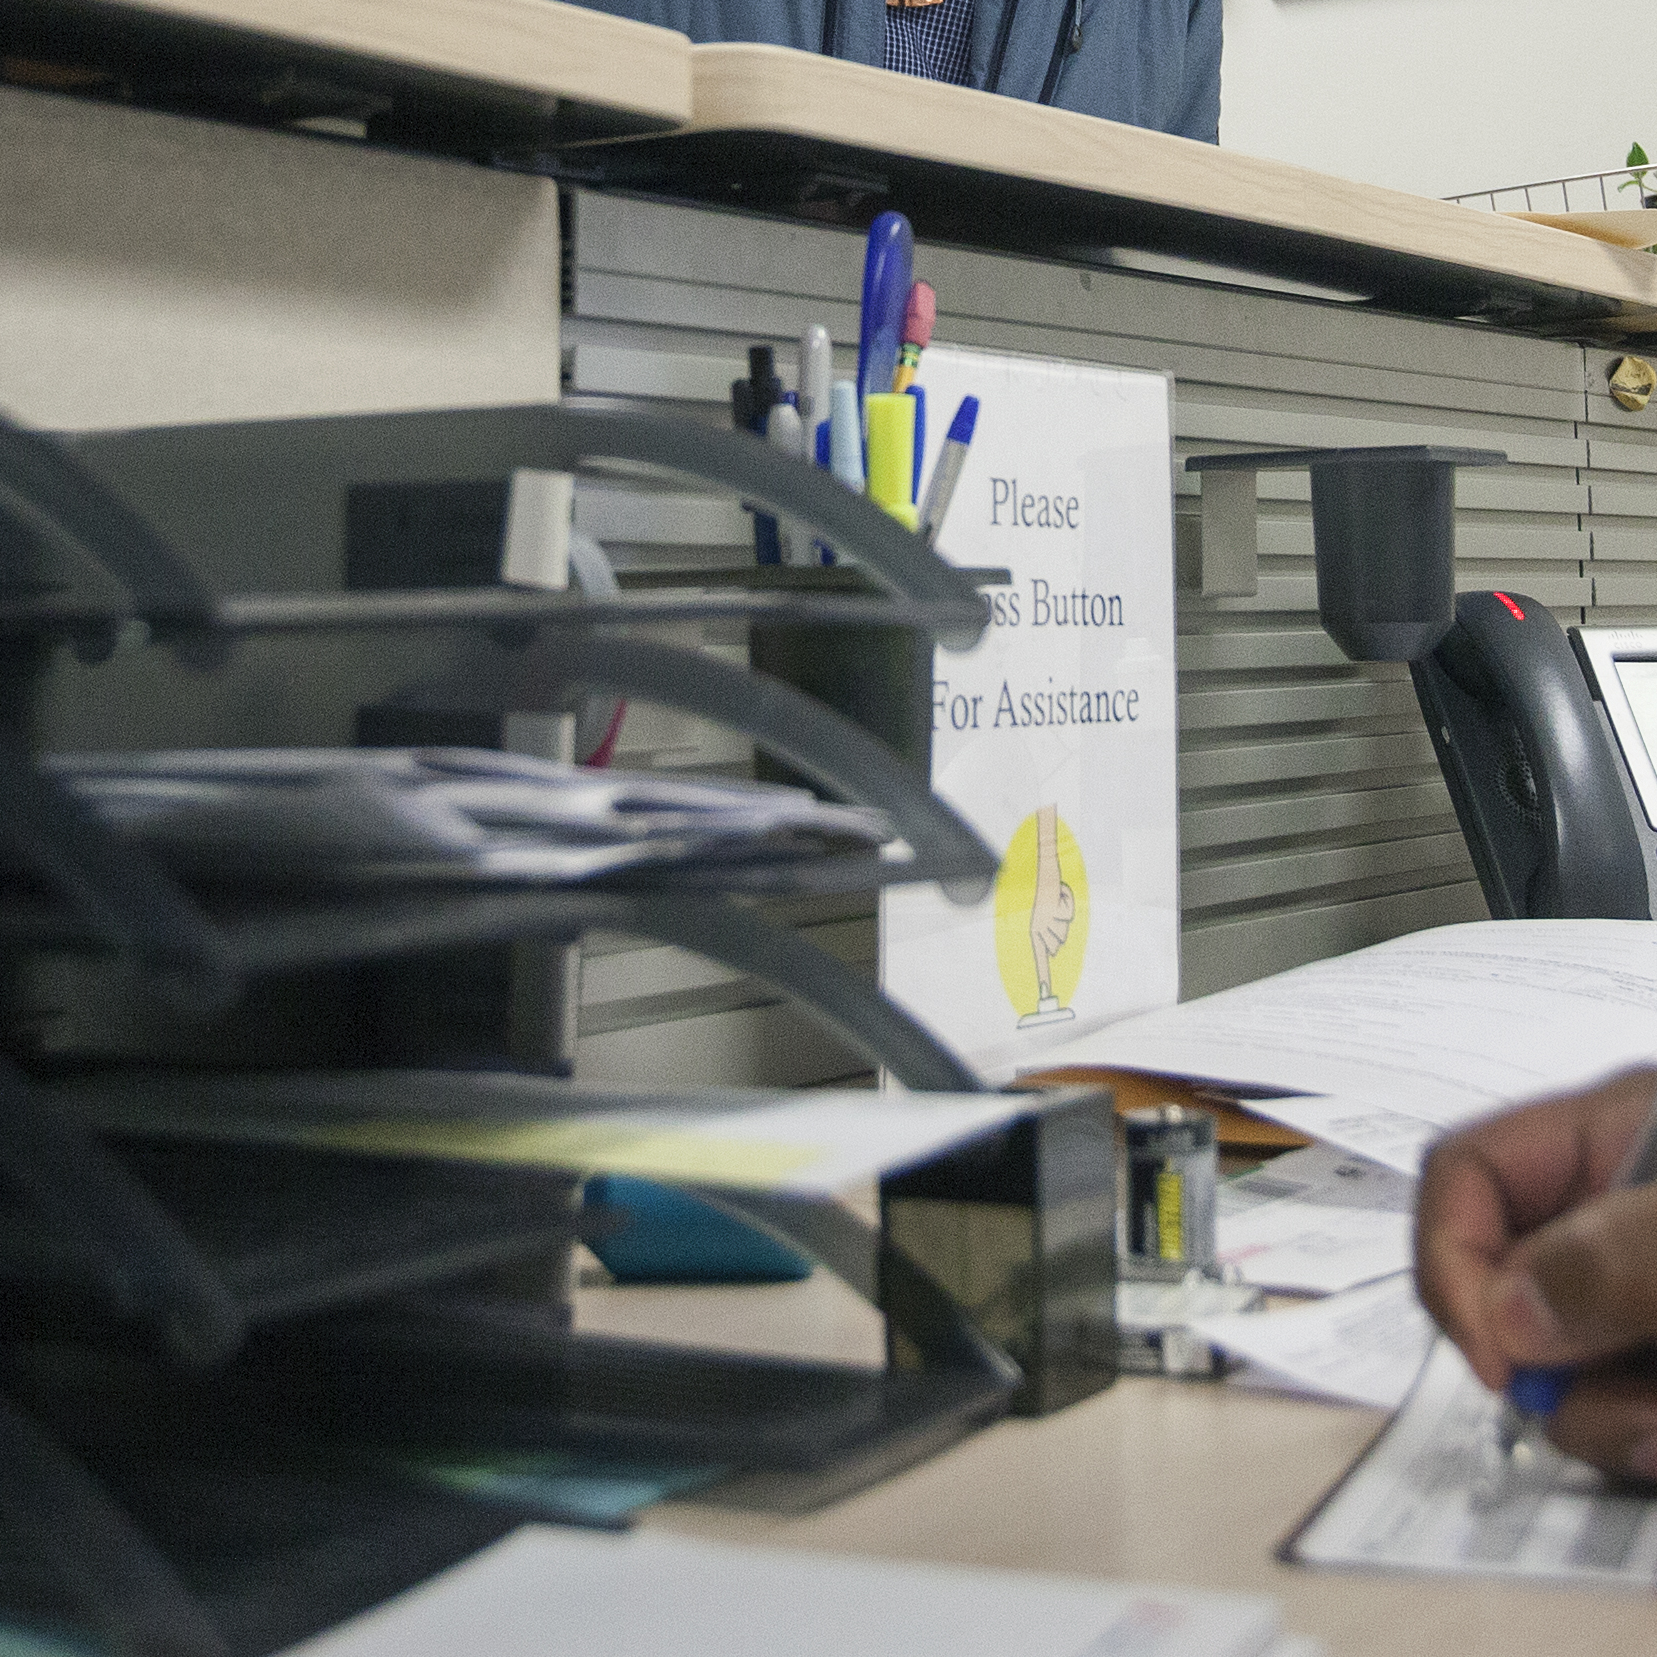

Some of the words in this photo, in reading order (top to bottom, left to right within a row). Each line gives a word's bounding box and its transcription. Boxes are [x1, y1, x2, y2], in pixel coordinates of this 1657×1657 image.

[990, 477, 1079, 529] Please
[1032, 579, 1125, 627] Button
[932, 680, 984, 730] For
[994, 676, 1139, 729] Assistance
